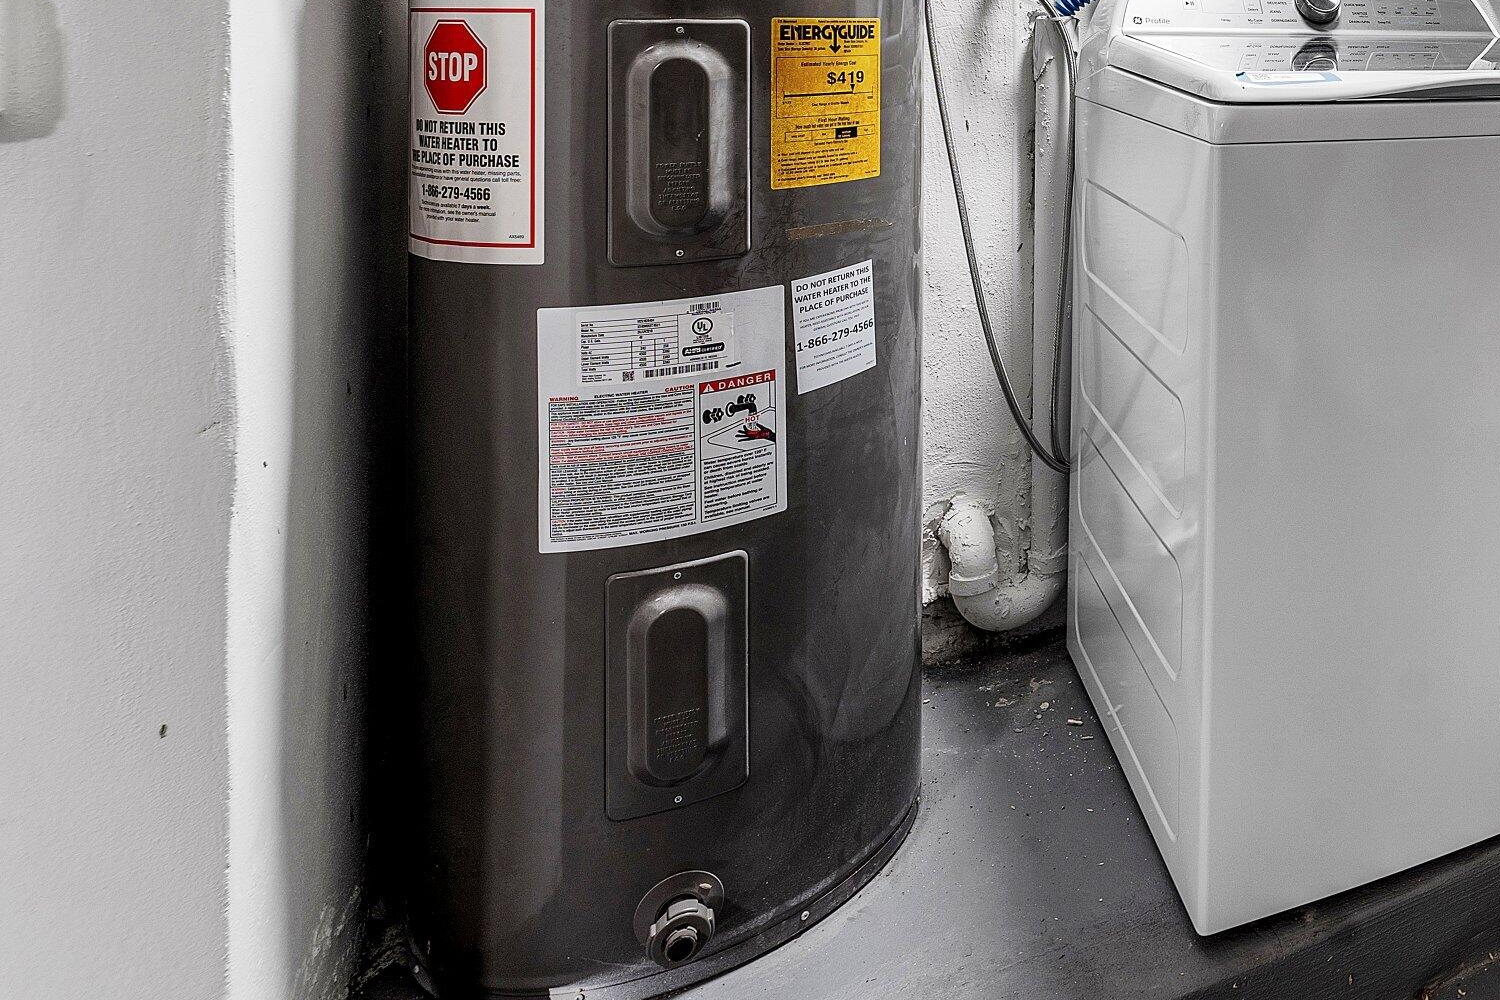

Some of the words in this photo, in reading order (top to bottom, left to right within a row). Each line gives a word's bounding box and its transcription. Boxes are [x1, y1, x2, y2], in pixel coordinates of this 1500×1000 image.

[780, 25, 874, 40] ENERGYGUIDE
[428, 52, 478, 82] STOP
[827, 71, 864, 85] $419
[416, 119, 422, 132] DO
[424, 120, 437, 133] NOT
[440, 121, 475, 134] RETURN
[479, 123, 506, 135] THIS
[419, 135, 440, 149] WATER
[442, 136, 478, 150] HEATER
[482, 139, 498, 151] TO
[422, 152, 441, 165] PLACE
[443, 153, 455, 166] OF
[459, 155, 519, 168] PURCHASE
[422, 184, 490, 200] 1-866-279-4566
[796, 284, 808, 292] DO
[811, 280, 826, 290] NOT
[828, 272, 854, 284] RETURN
[856, 266, 869, 276] THIS
[794, 292, 821, 303] WATER
[823, 282, 849, 296] HEATER
[850, 280, 858, 289] TO
[860, 276, 871, 285] THE
[800, 302, 822, 313] PLACE
[836, 287, 868, 303] PURCHASE
[797, 318, 873, 352] 1-866-279-4566
[665, 384, 694, 392] CAUTION
[719, 373, 770, 389] DANGER
